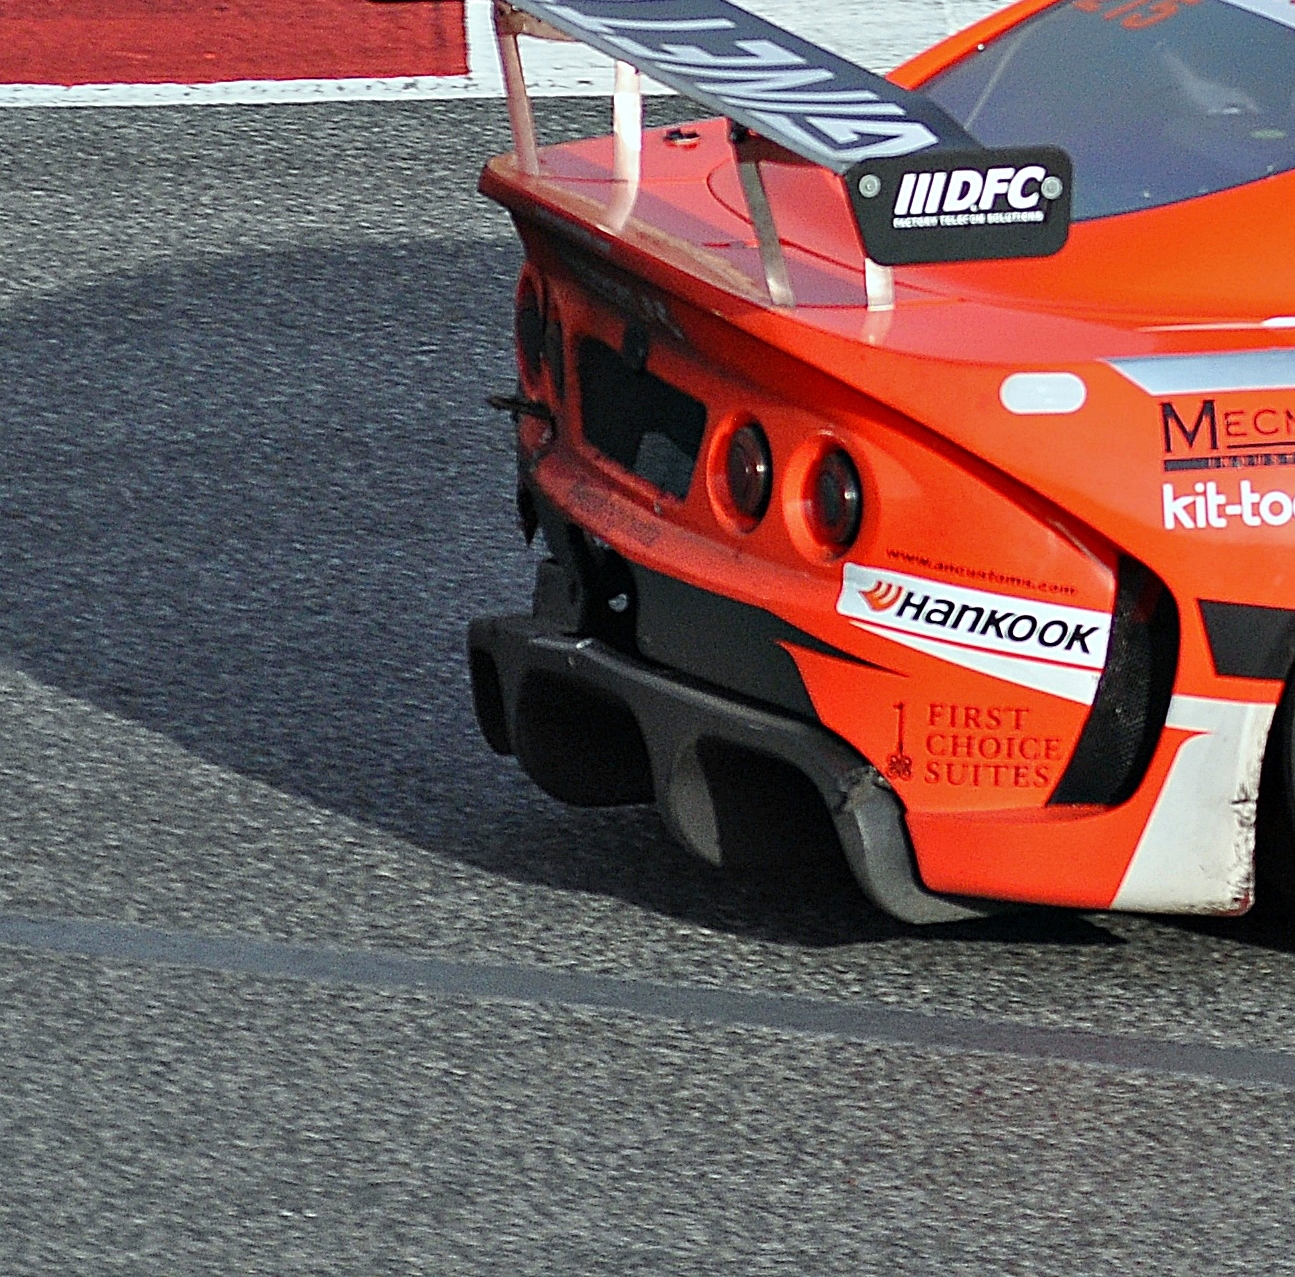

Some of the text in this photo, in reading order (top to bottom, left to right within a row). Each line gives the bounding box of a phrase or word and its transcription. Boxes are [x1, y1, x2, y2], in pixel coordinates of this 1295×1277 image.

[928, 702, 1031, 732] FIRST
[925, 733, 1063, 761] CHOICE
[923, 761, 1051, 789] SUITES
